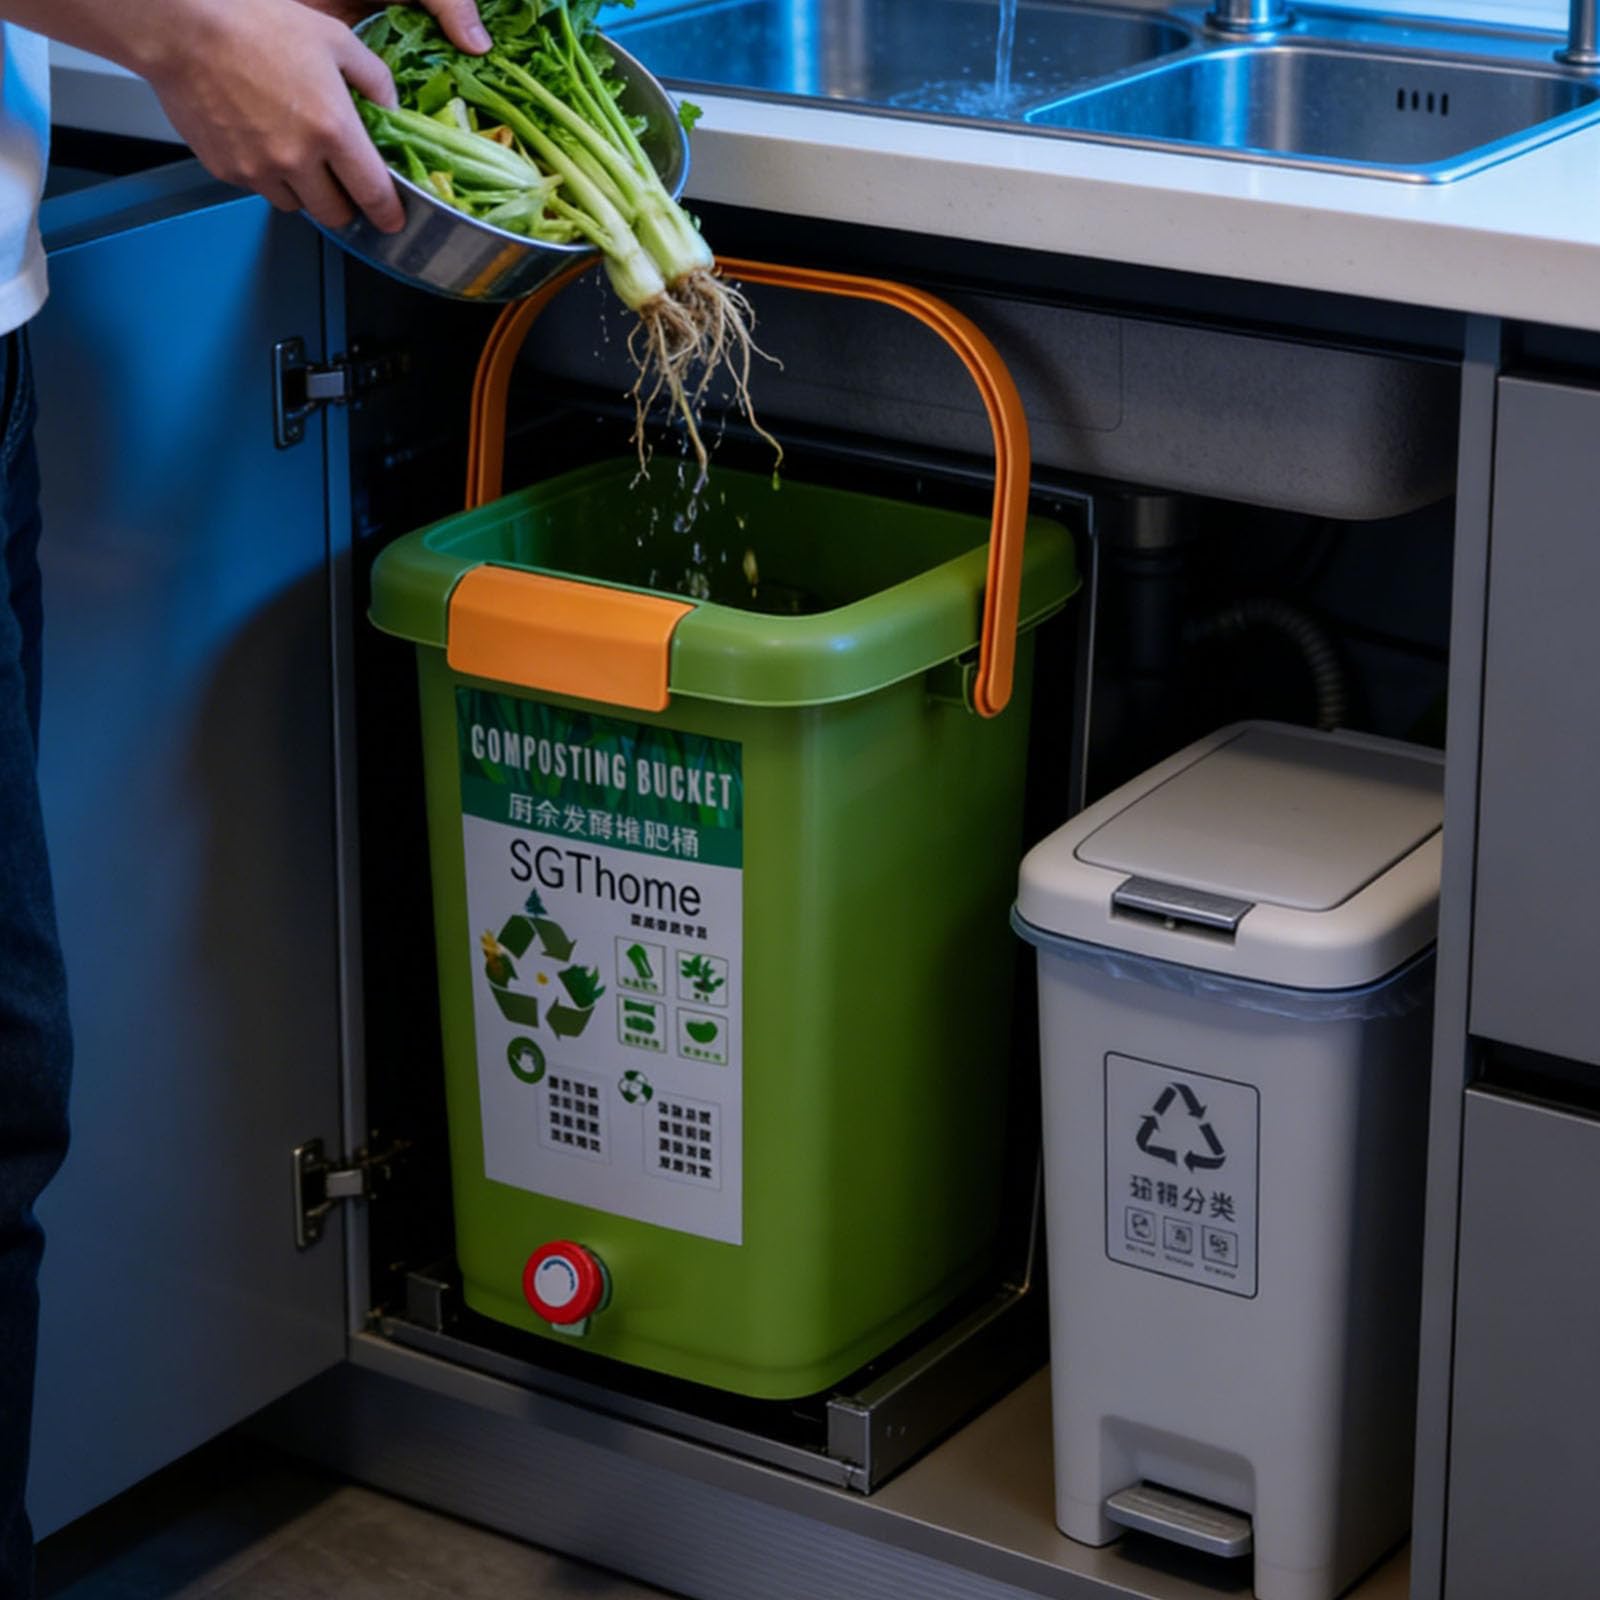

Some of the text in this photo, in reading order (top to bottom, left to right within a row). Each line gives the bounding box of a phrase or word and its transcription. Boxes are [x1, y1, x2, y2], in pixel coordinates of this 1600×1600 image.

[470, 723, 733, 811] COMPOSTING BUCKET
[509, 838, 702, 917] SGThome
